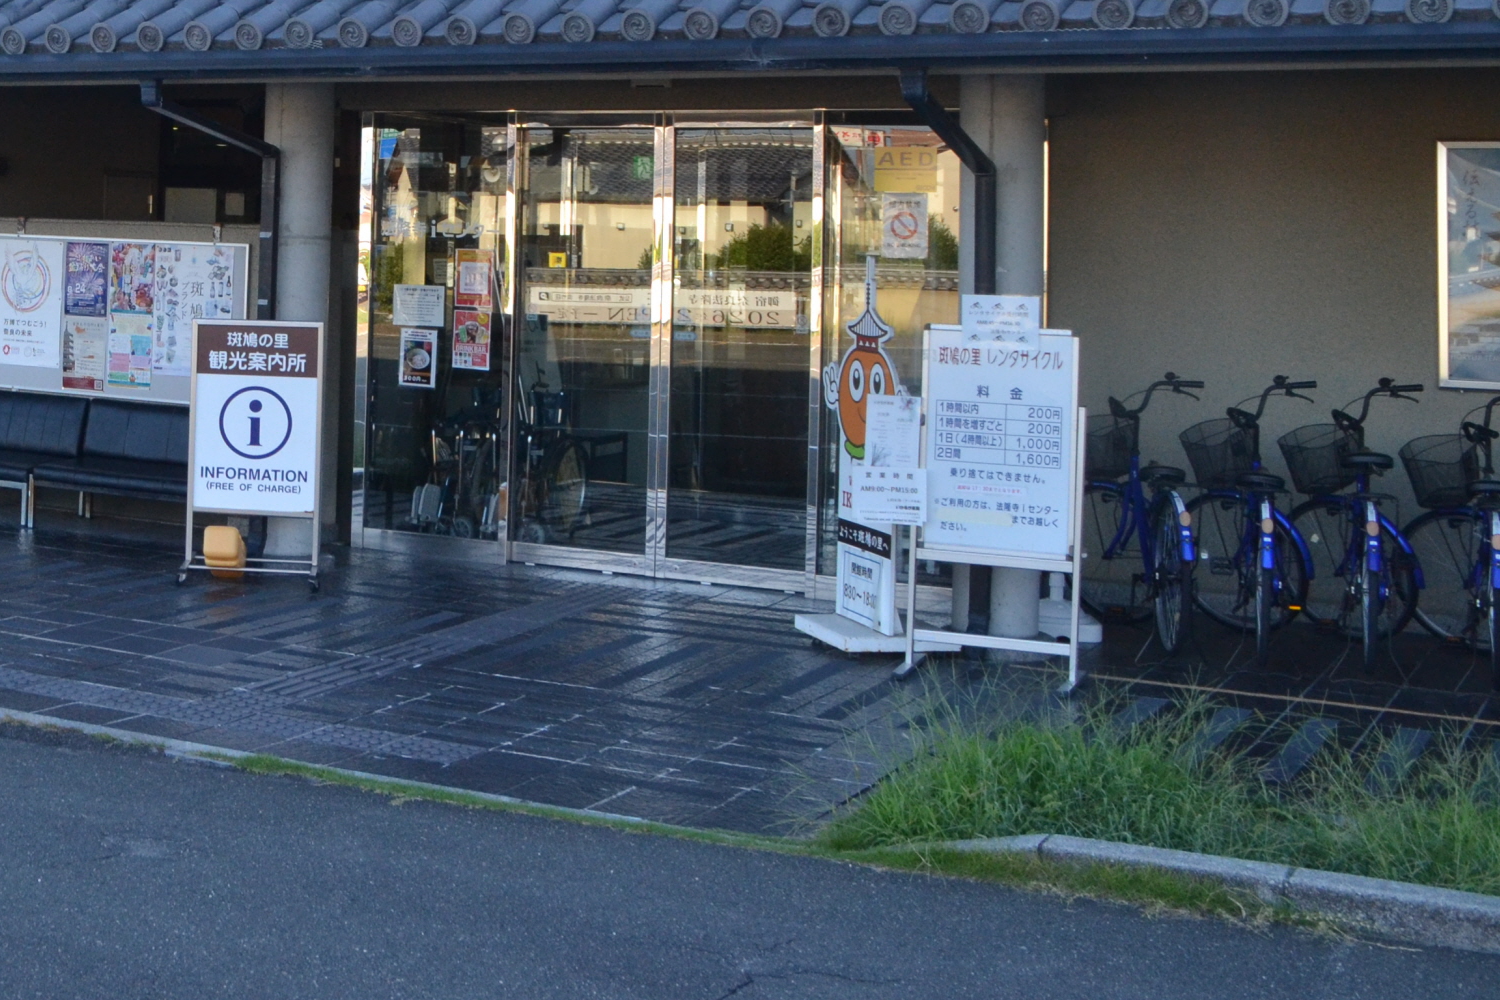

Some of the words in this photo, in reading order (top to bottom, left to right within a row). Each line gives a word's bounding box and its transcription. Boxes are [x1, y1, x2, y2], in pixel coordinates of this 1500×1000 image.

[877, 151, 934, 167] AED
[3, 328, 33, 337] 奈良の未来
[227, 332, 289, 349] 斑鳩の里
[208, 350, 307, 373] 観光案内所
[938, 346, 982, 366] 斑鳩の里
[987, 349, 1064, 370] レンタサイクル
[940, 402, 980, 415] 1時間以内
[1027, 407, 1061, 420] 200円
[939, 417, 1004, 432] 1時間を増すごと
[1027, 423, 1061, 435] 200円
[1016, 437, 1060, 451] 1,000円
[936, 446, 961, 460] 2日間
[1015, 452, 1060, 467] 1,600円
[200, 466, 308, 483] INFORMATION
[950, 467, 1046, 485] 乗り捨てはできません。
[206, 480, 235, 491] (FREE
[239, 482, 253, 492] OF
[257, 484, 302, 495] CHARGE)
[940, 521, 968, 532] ださい。
[1011, 515, 1059, 529] までお越しく
[839, 525, 889, 551] ようこそ斑鳩の里へ
